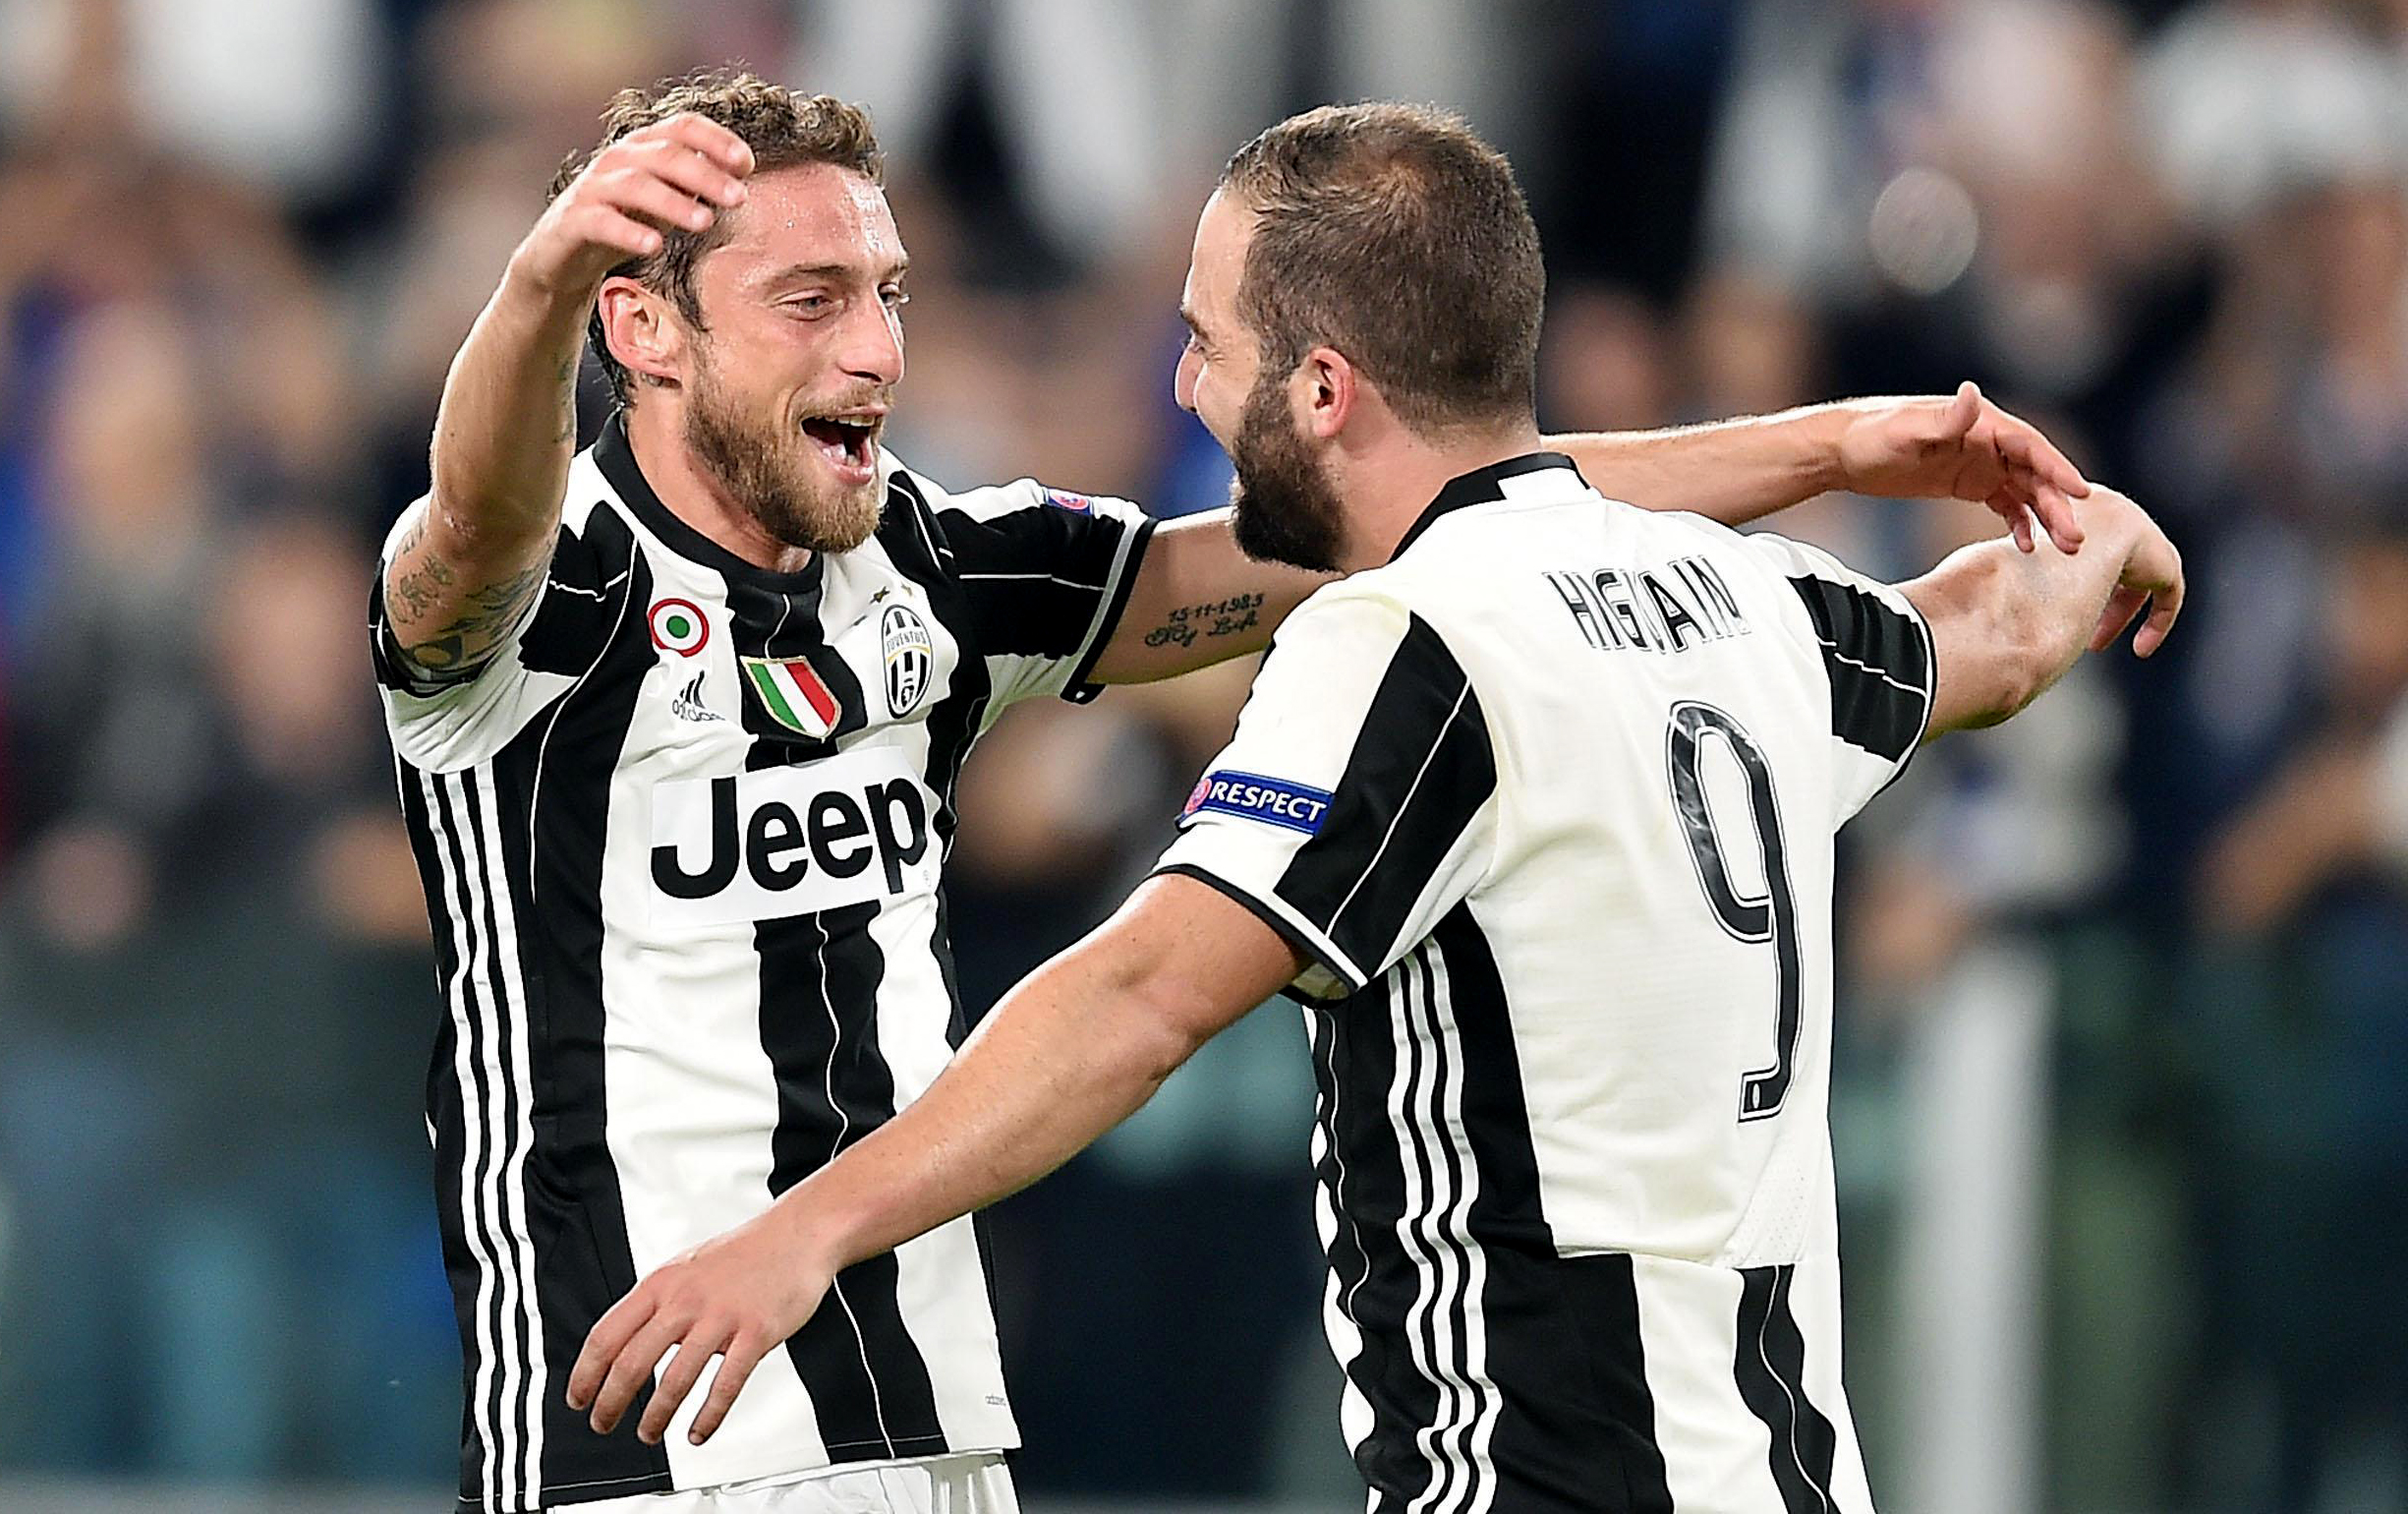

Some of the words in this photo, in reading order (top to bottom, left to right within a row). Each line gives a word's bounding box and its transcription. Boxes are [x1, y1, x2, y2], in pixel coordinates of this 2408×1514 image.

[887, 630, 927, 653] JUVENTUS
[652, 776, 928, 899] Jeep
[1209, 782, 1327, 822] RESPECT
[1666, 700, 1804, 1123] 9
